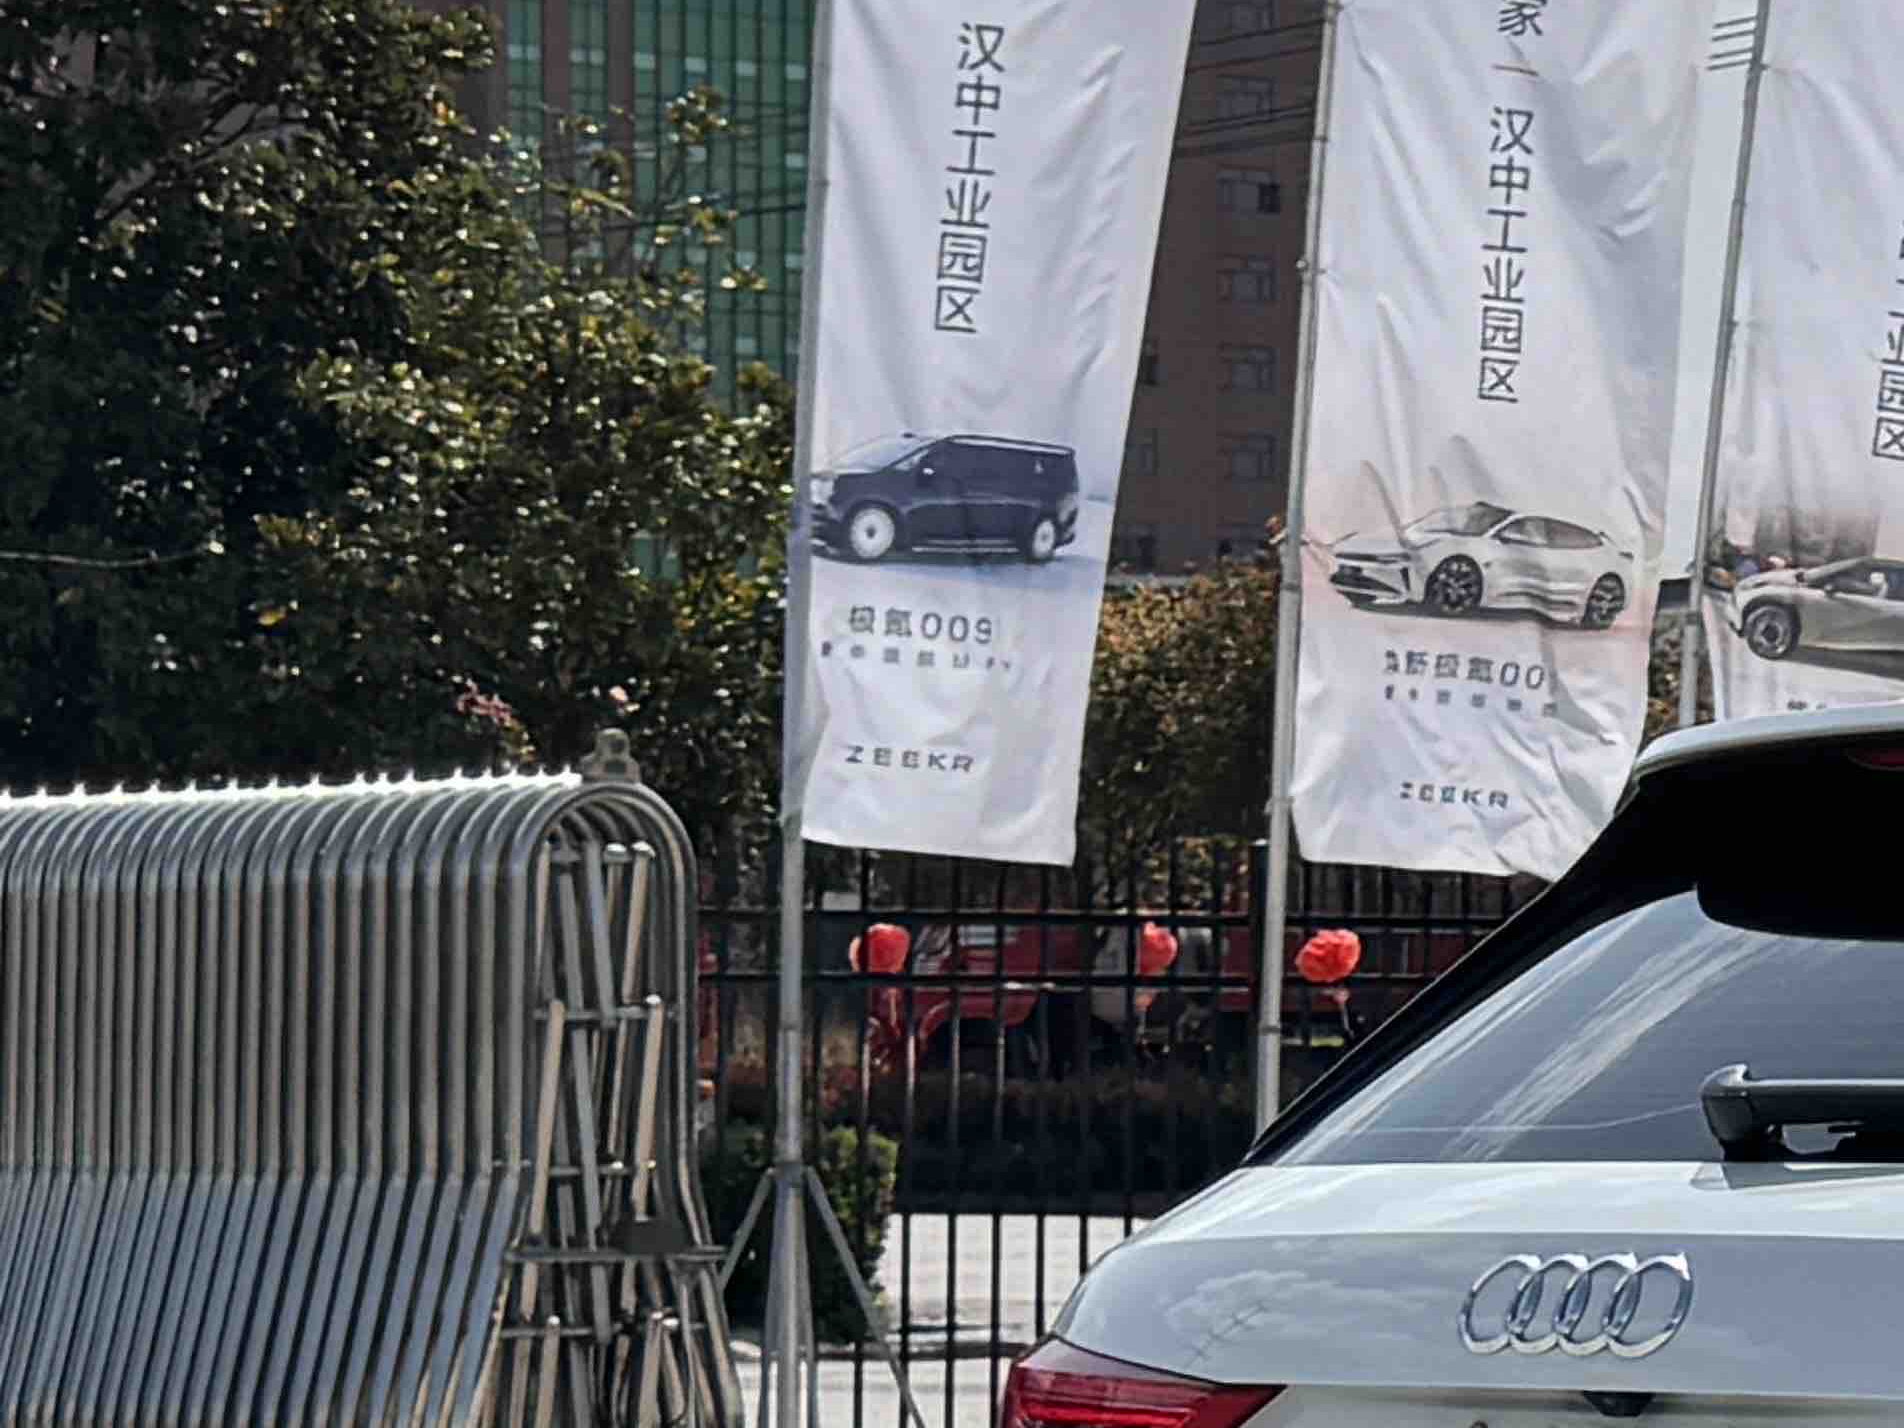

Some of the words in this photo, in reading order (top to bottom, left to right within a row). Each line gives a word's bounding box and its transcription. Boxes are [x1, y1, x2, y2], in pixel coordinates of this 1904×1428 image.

[933, 20, 1005, 334] 汉中工业园区
[1477, 105, 1535, 404] 汉中工业园区
